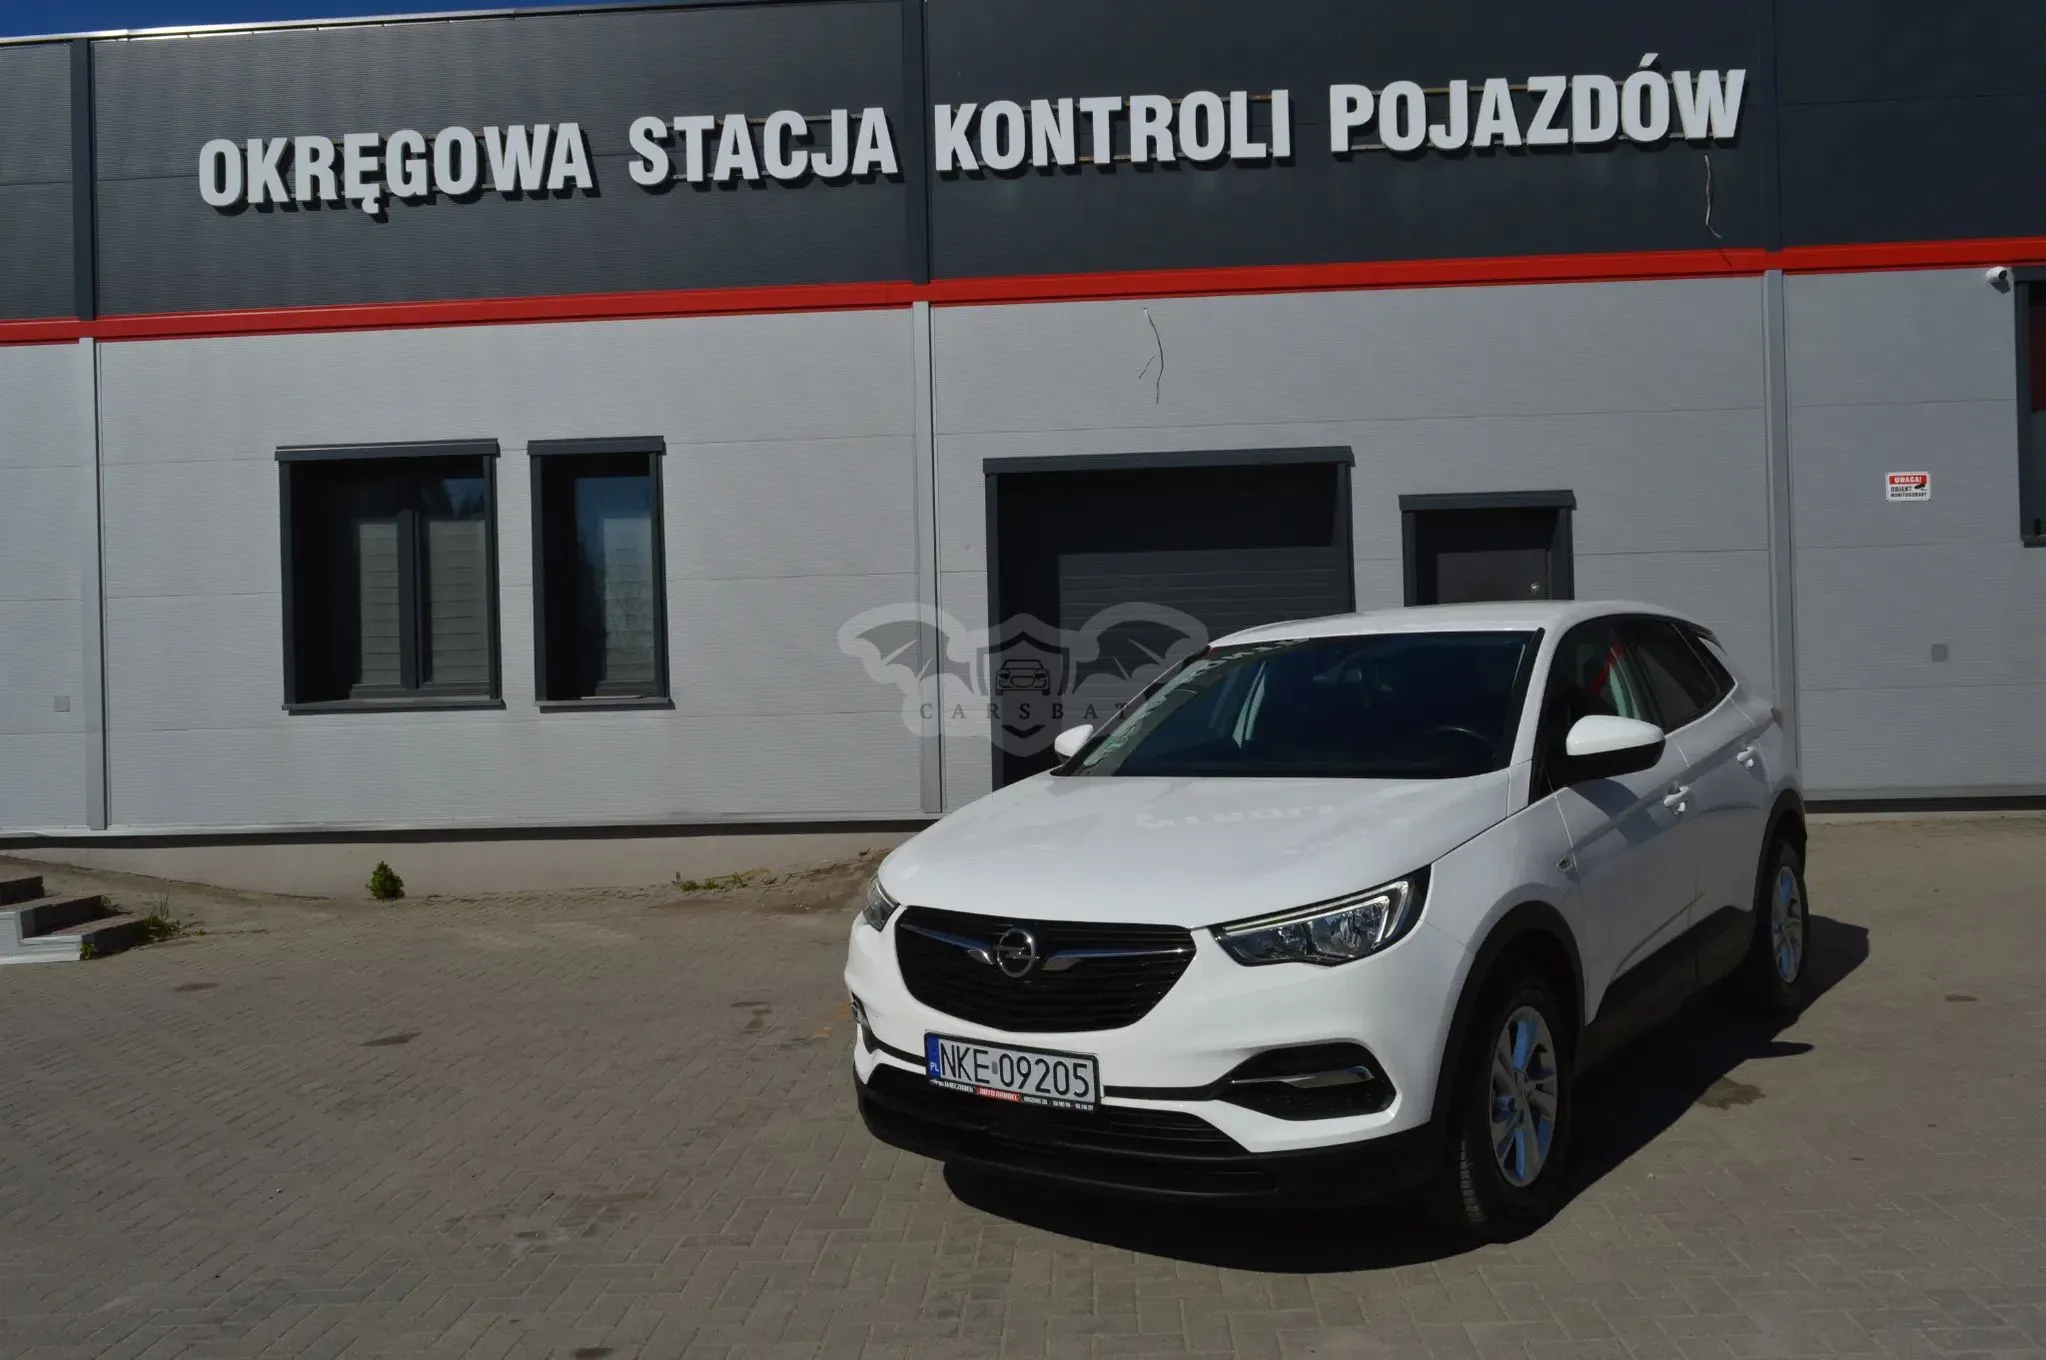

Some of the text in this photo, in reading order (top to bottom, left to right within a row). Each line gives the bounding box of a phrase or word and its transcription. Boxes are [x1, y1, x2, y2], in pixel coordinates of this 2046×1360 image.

[198, 52, 1746, 214] OKRĘGOWA STACJA KONTROLI POJAZDÓW
[930, 1062, 940, 1073] PL
[940, 1042, 1089, 1097] NKE 09205
